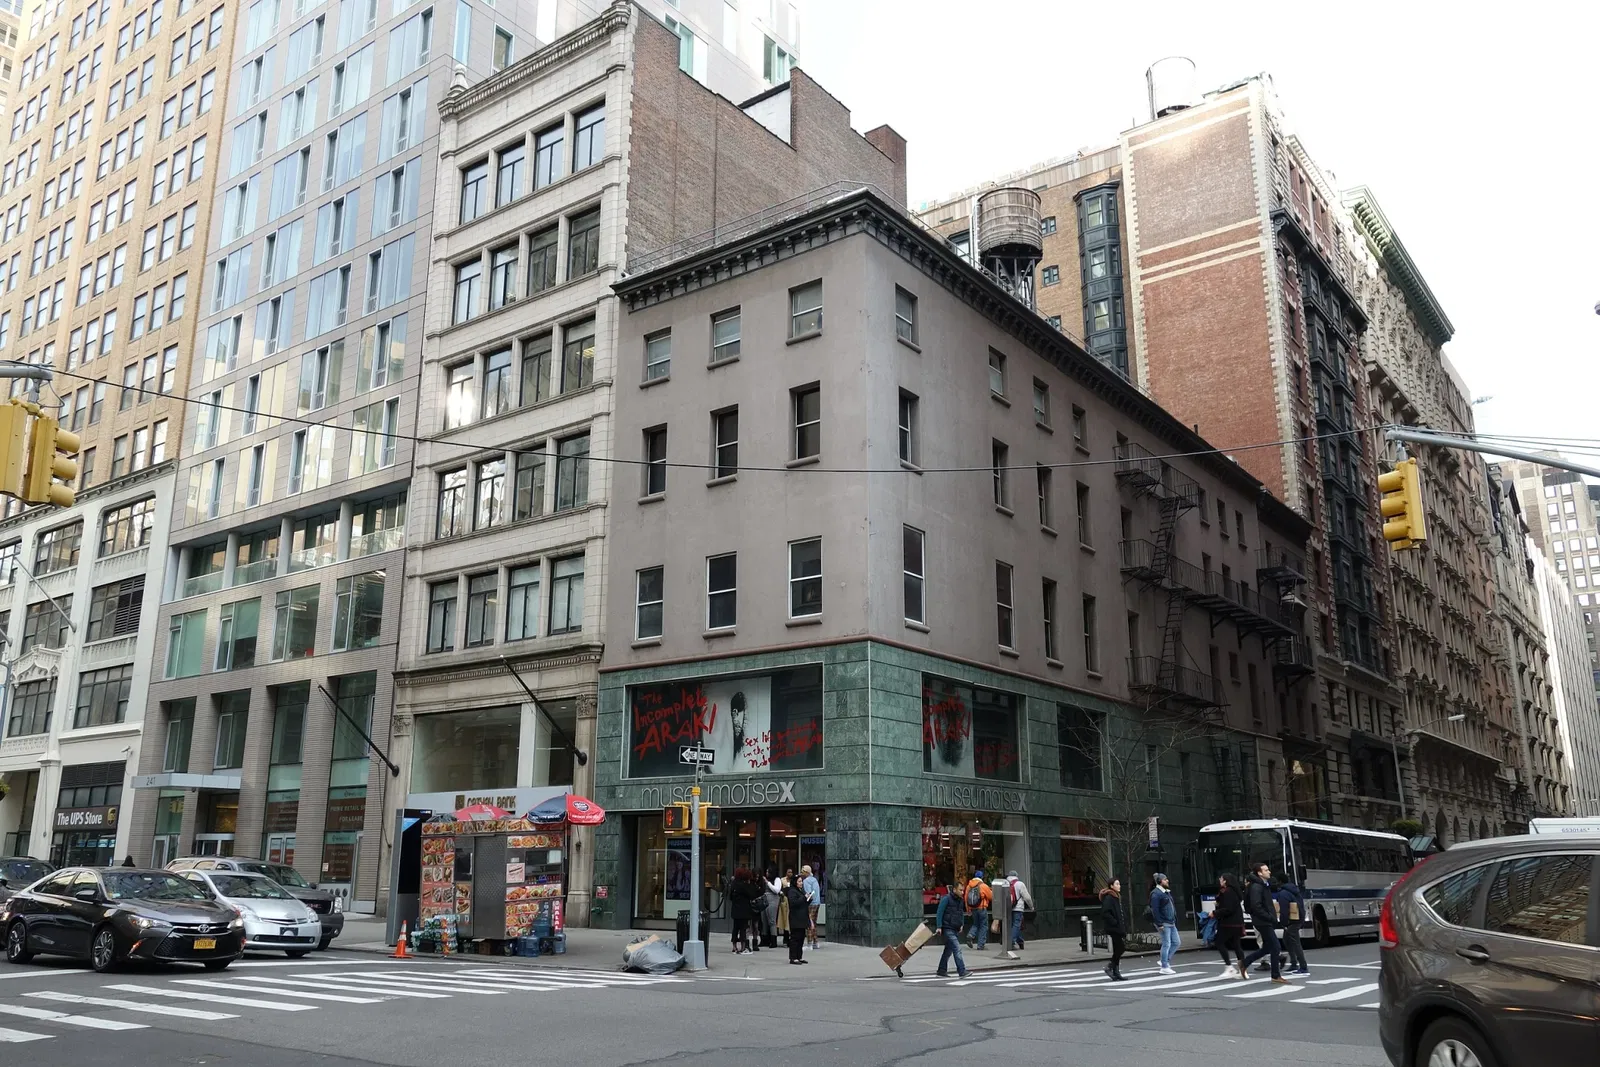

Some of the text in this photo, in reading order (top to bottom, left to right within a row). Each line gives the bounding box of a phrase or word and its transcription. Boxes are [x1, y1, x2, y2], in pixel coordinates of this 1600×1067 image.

[634, 687, 708, 732] Incomplete
[633, 702, 718, 761] ARAKI
[685, 751, 696, 759] ONE
[497, 795, 517, 808] BANK
[57, 812, 69, 825] The
[70, 811, 84, 825] UPS
[84, 812, 102, 825] Store
